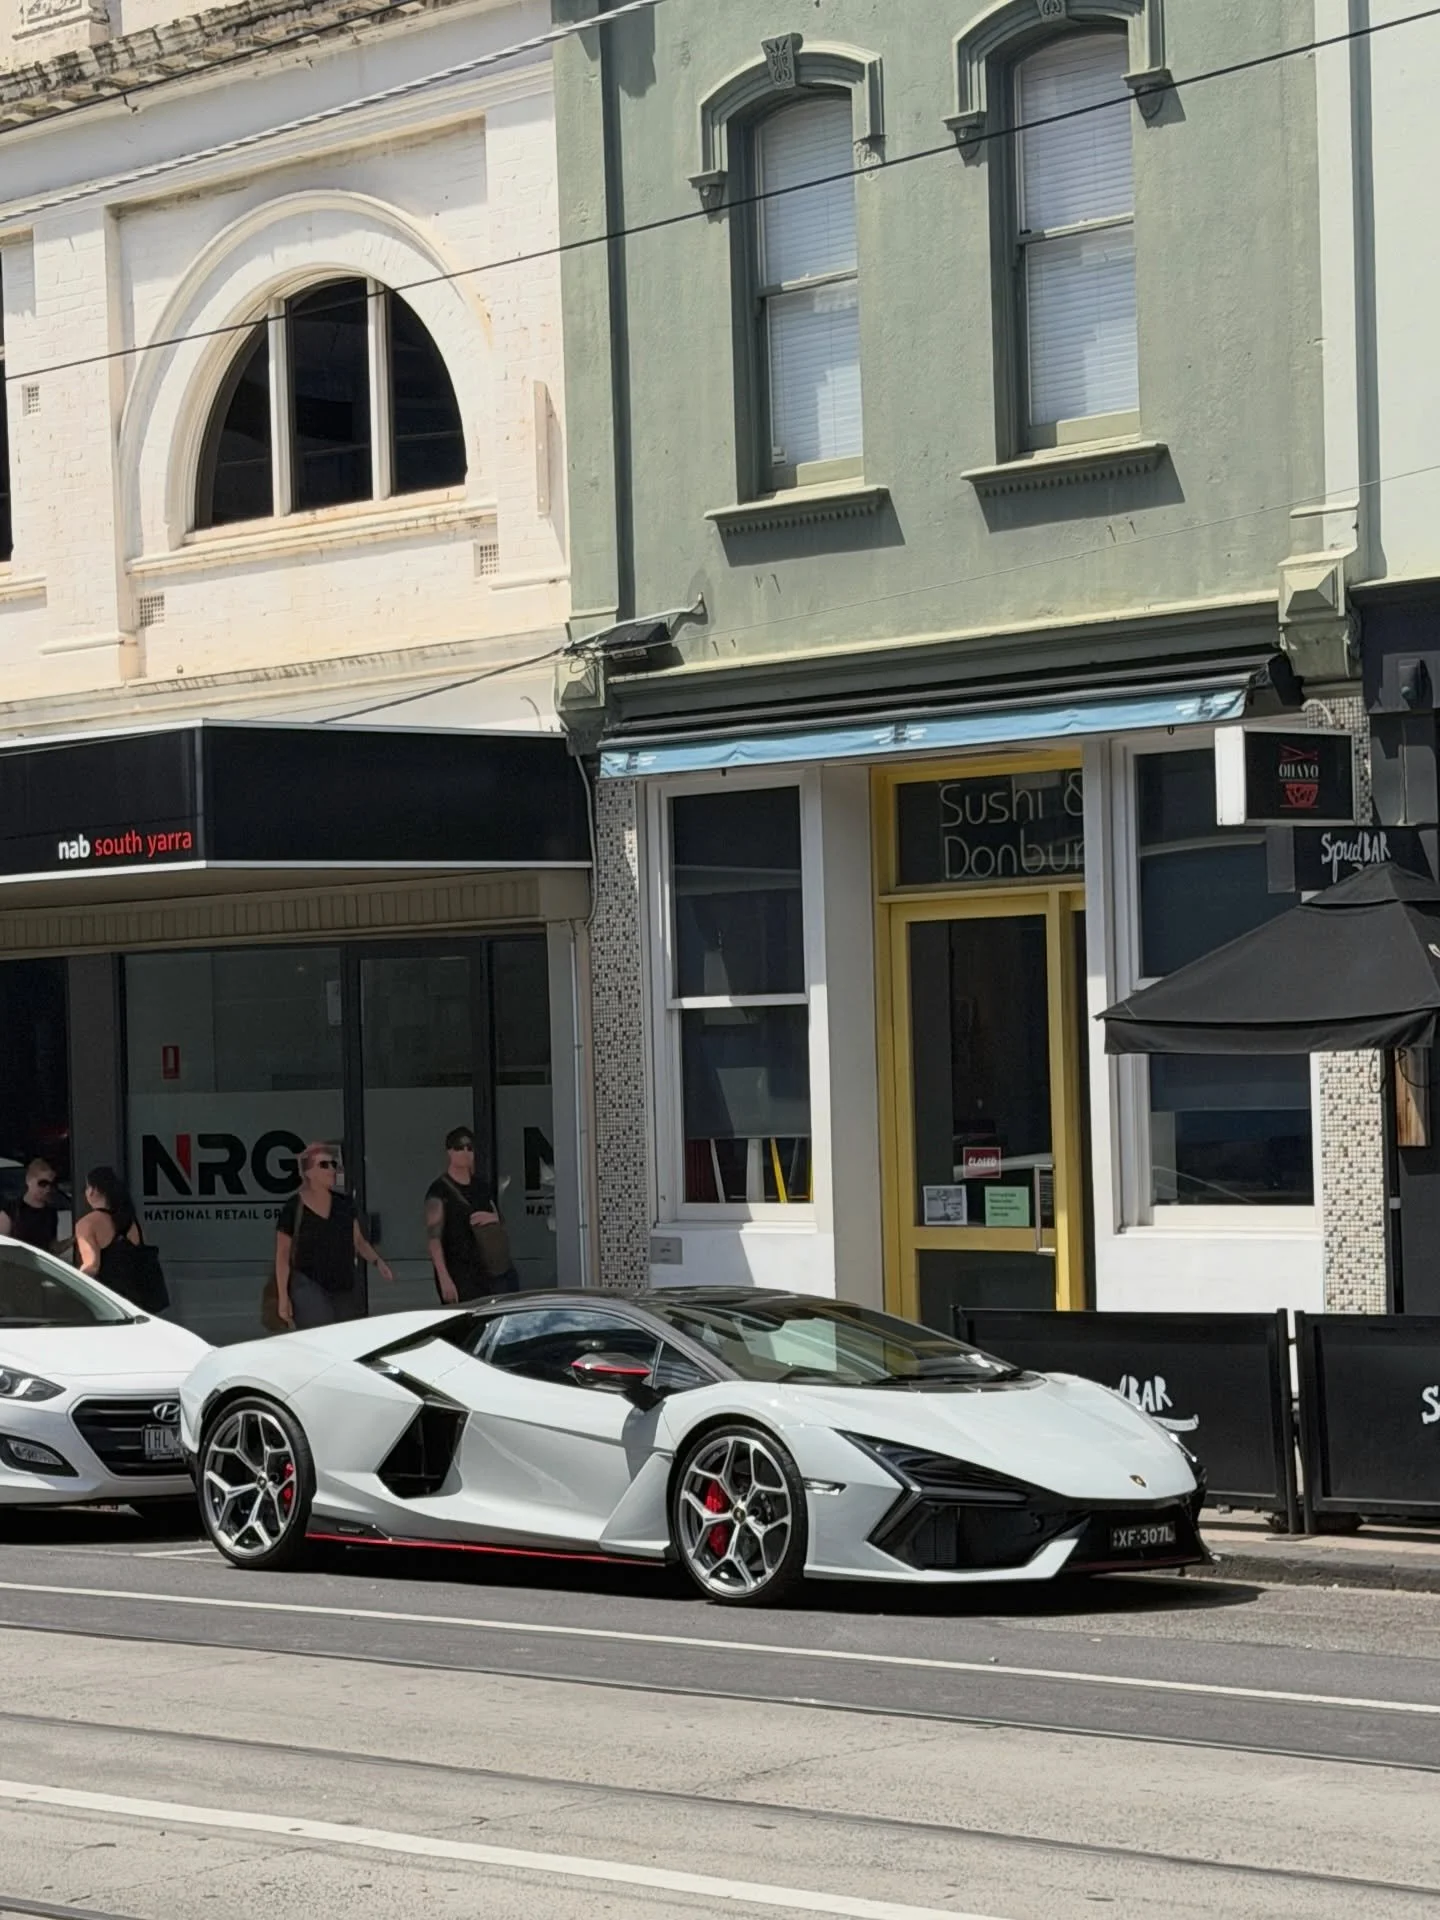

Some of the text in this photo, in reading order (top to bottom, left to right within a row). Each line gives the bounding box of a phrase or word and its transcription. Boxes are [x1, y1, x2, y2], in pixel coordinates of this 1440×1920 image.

[1279, 763, 1319, 778] OHAYO
[940, 779, 1043, 828] Sushi
[58, 829, 192, 860] nab south yarra
[142, 1130, 308, 1196] NRG
[144, 1208, 211, 1221] NATIONAL
[215, 1207, 259, 1220] RETAIL
